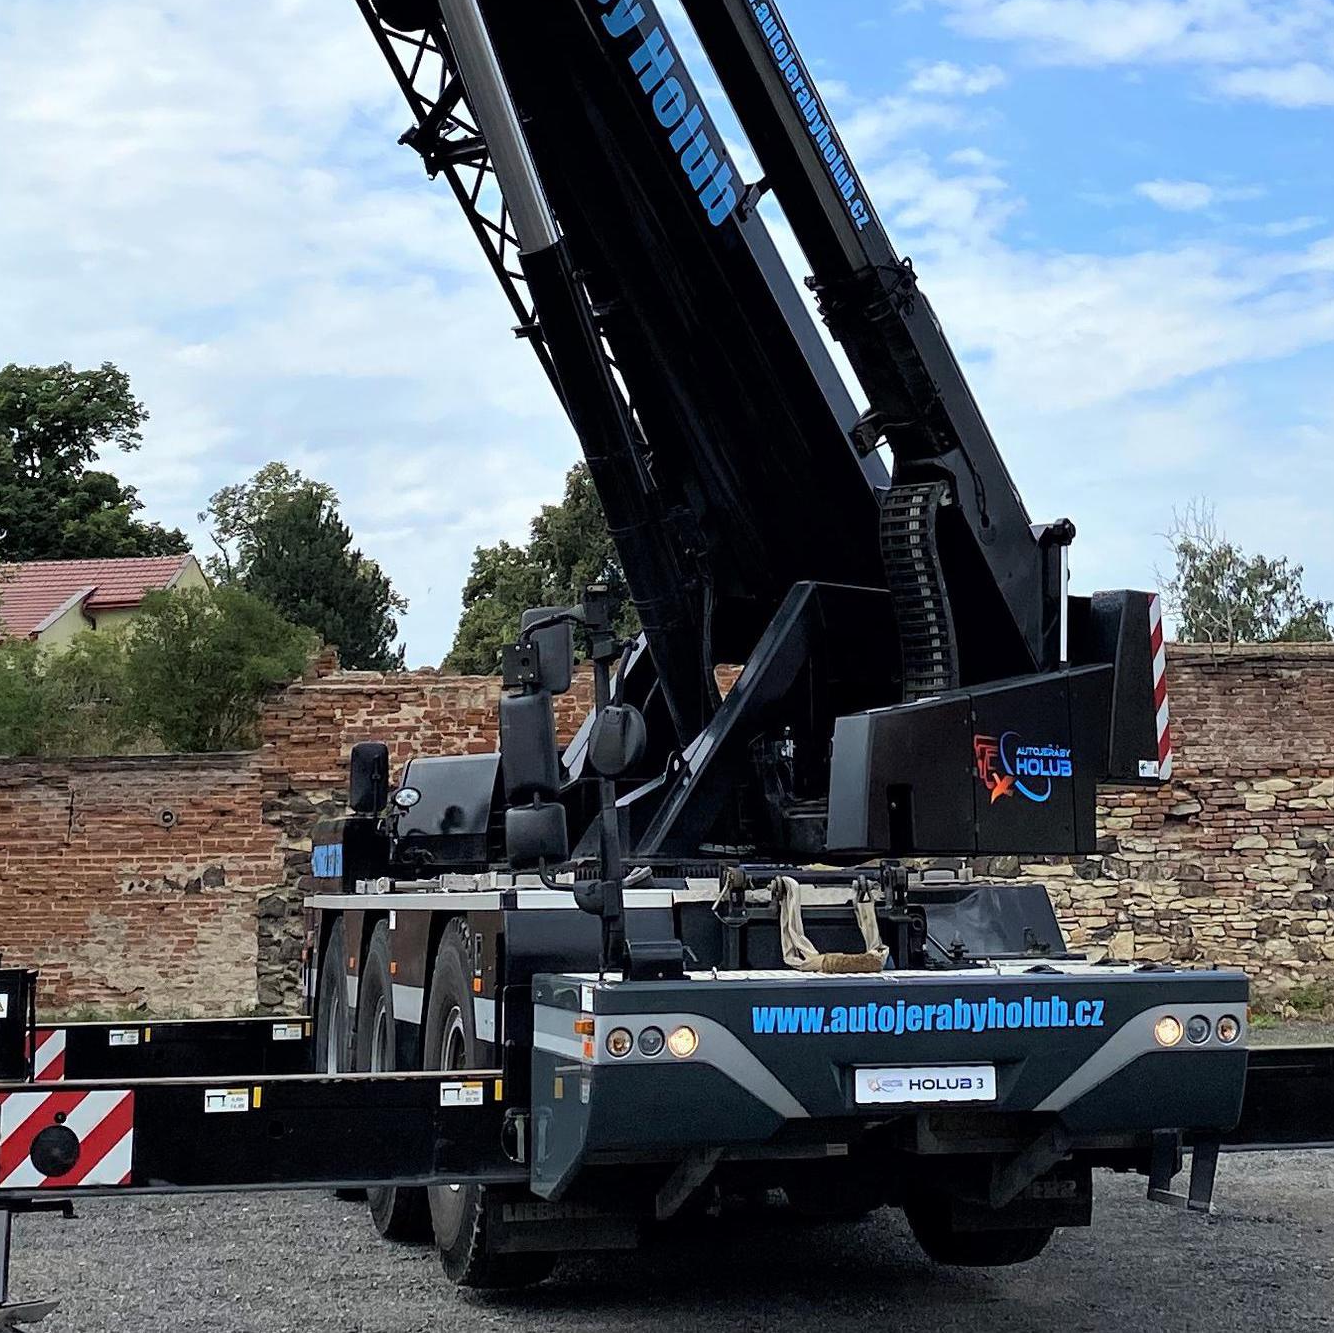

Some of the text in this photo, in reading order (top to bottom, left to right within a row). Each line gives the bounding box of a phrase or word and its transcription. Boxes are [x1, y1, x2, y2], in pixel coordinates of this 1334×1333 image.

[627, 26, 737, 227] Holub
[1015, 757, 1073, 777] HOLUB
[751, 996, 1105, 1035] www.autojerabyholub.cz
[909, 1078, 973, 1090] HOLUB
[976, 1078, 984, 1090] 3
